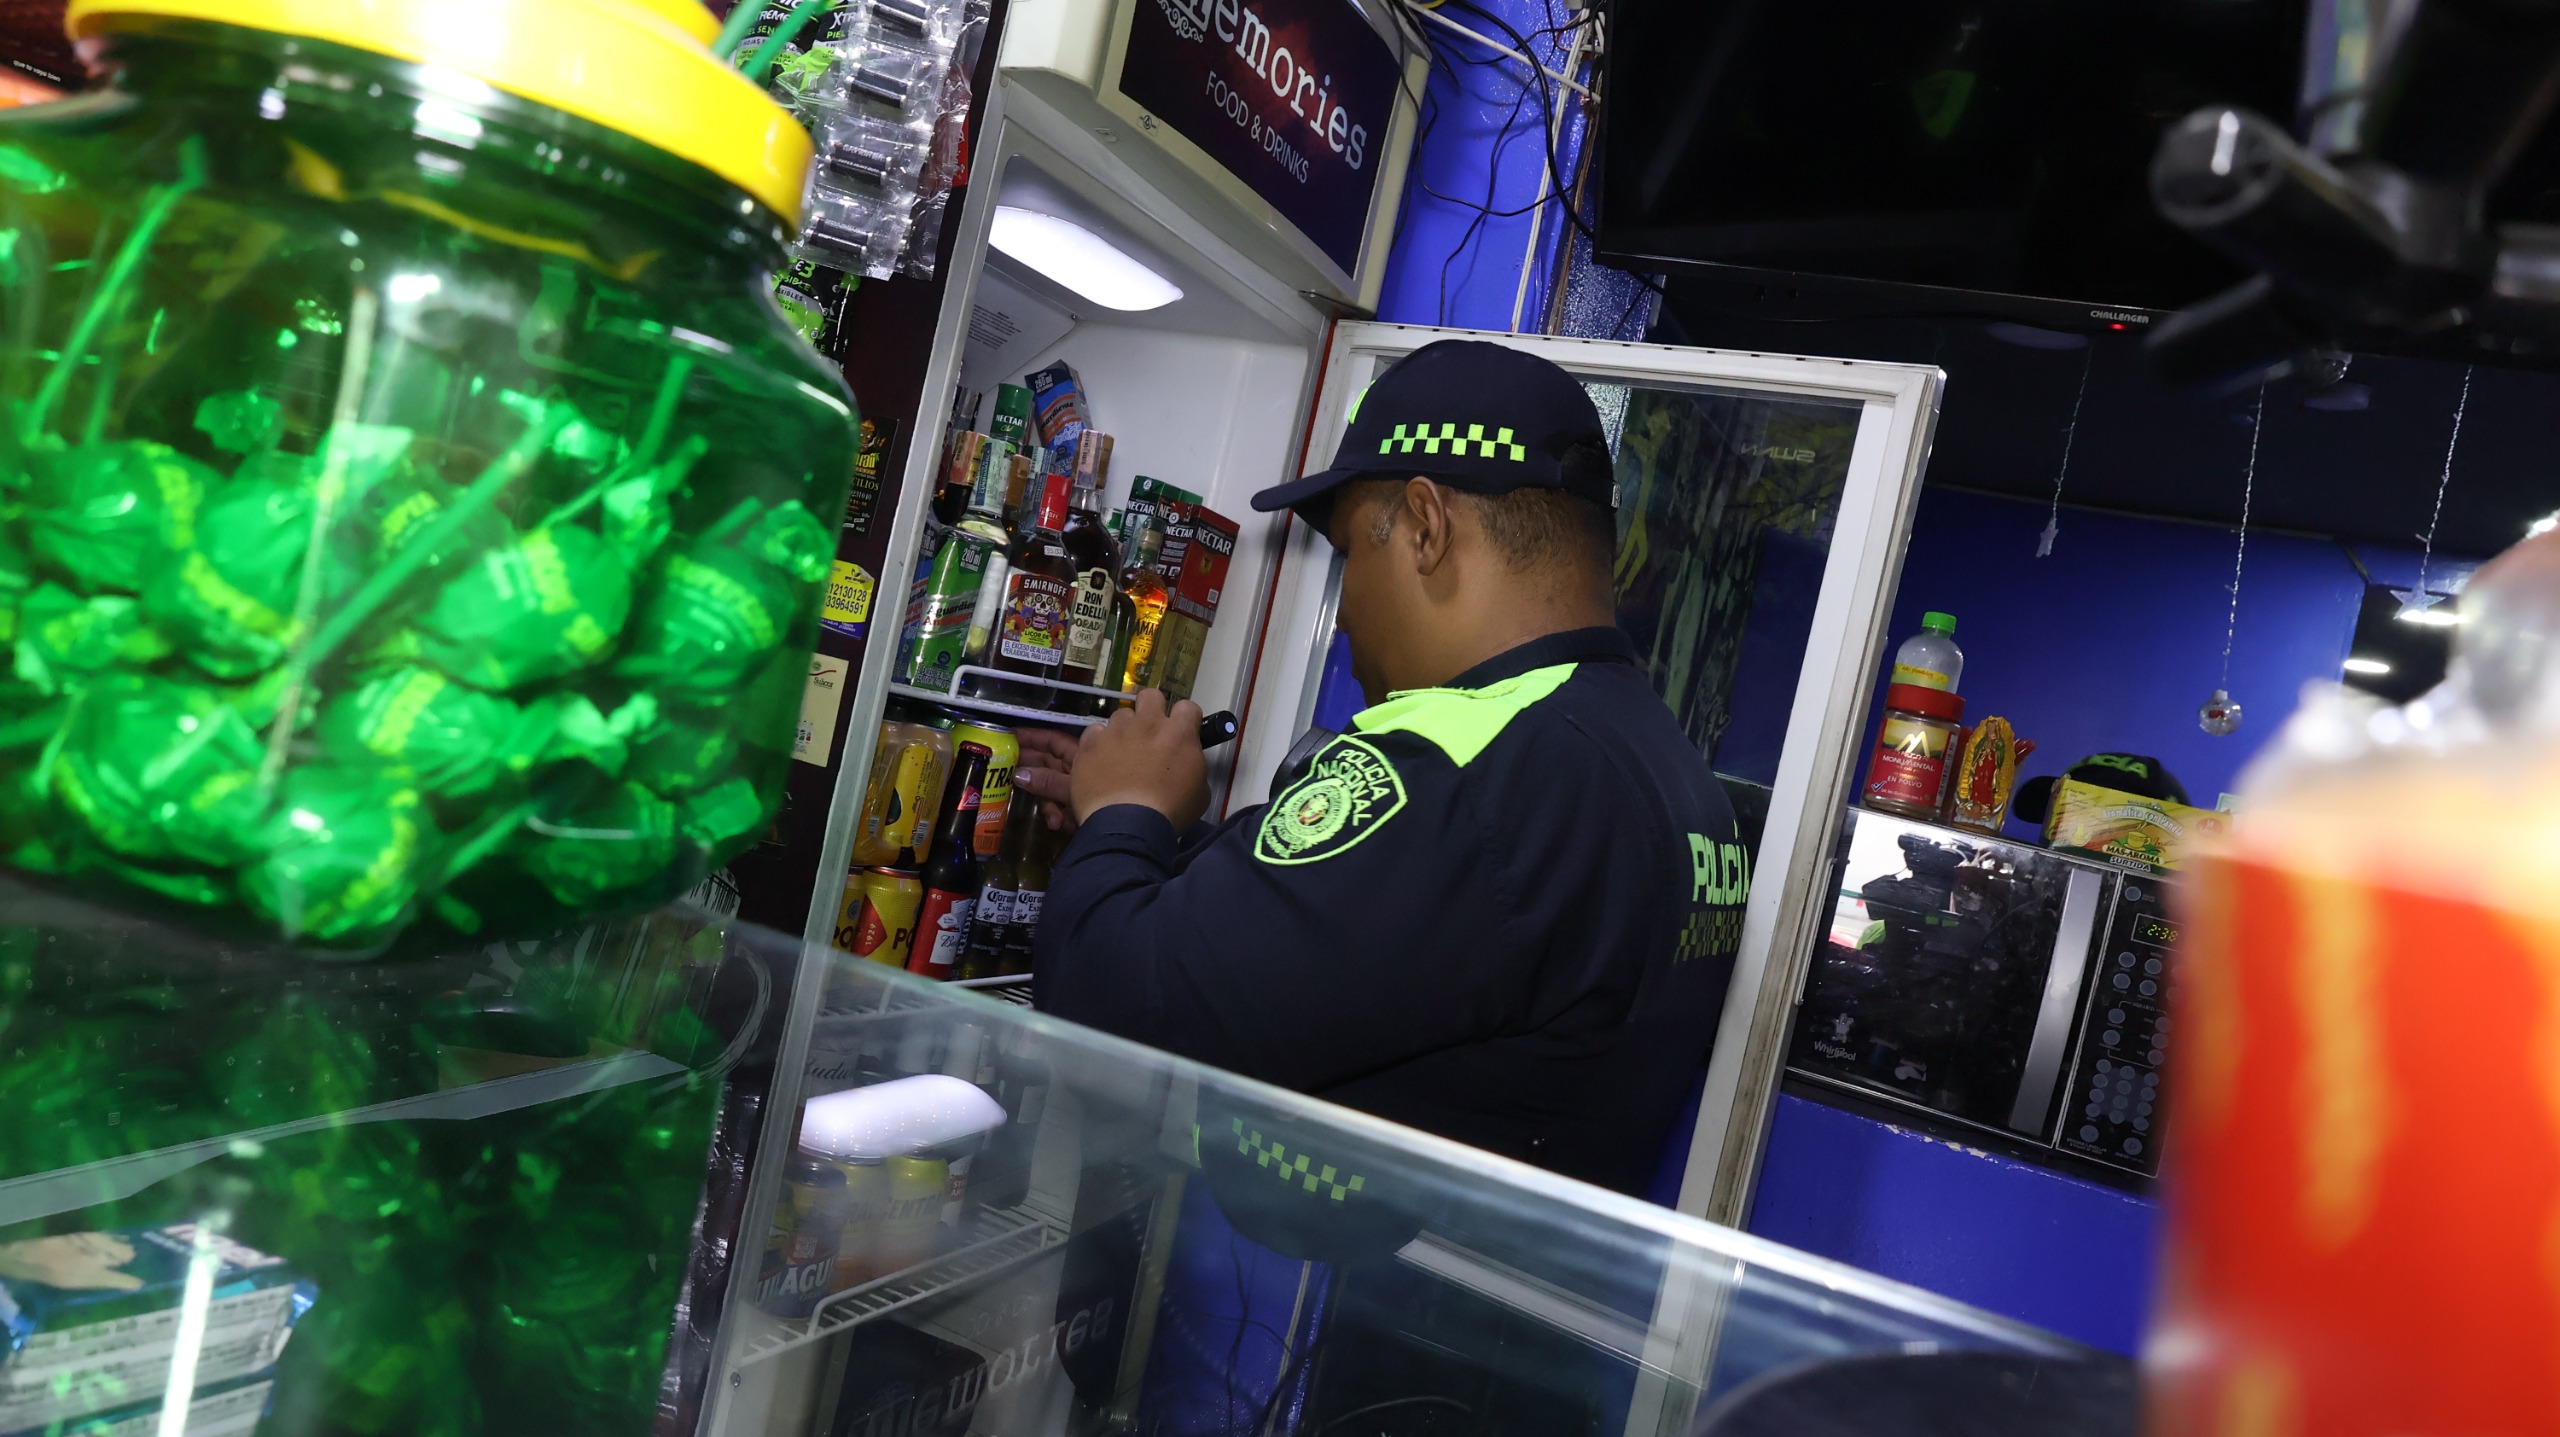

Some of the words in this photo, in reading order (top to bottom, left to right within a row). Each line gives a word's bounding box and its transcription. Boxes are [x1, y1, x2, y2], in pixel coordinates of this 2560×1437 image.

[1206, 70, 1249, 128] FOOD
[1250, 114, 1262, 142] &
[1264, 126, 1310, 184] DRINKS
[2090, 310, 2149, 324] CHALLENGER
[996, 414, 1023, 427] NECTAR
[1128, 500, 1155, 515] NECTAR
[1165, 525, 1194, 538] NECTAR
[1195, 526, 1233, 556] NECTAR
[1023, 578, 1067, 597] SMIRNOFF
[1084, 591, 1104, 606] RON
[1882, 755, 1936, 772] MONUMENTAL
[1336, 749, 1391, 801] POLICÍA
[1317, 760, 1373, 826] NACIONAL
[2103, 806, 2144, 819] Aromática
[2144, 812, 2159, 823] con
[2106, 845, 2161, 864] MAS-AROMA
[2109, 856, 2151, 872] SURTIDA
[865, 923, 876, 945] 1929
[1814, 1040, 1857, 1062] Whirlpool
